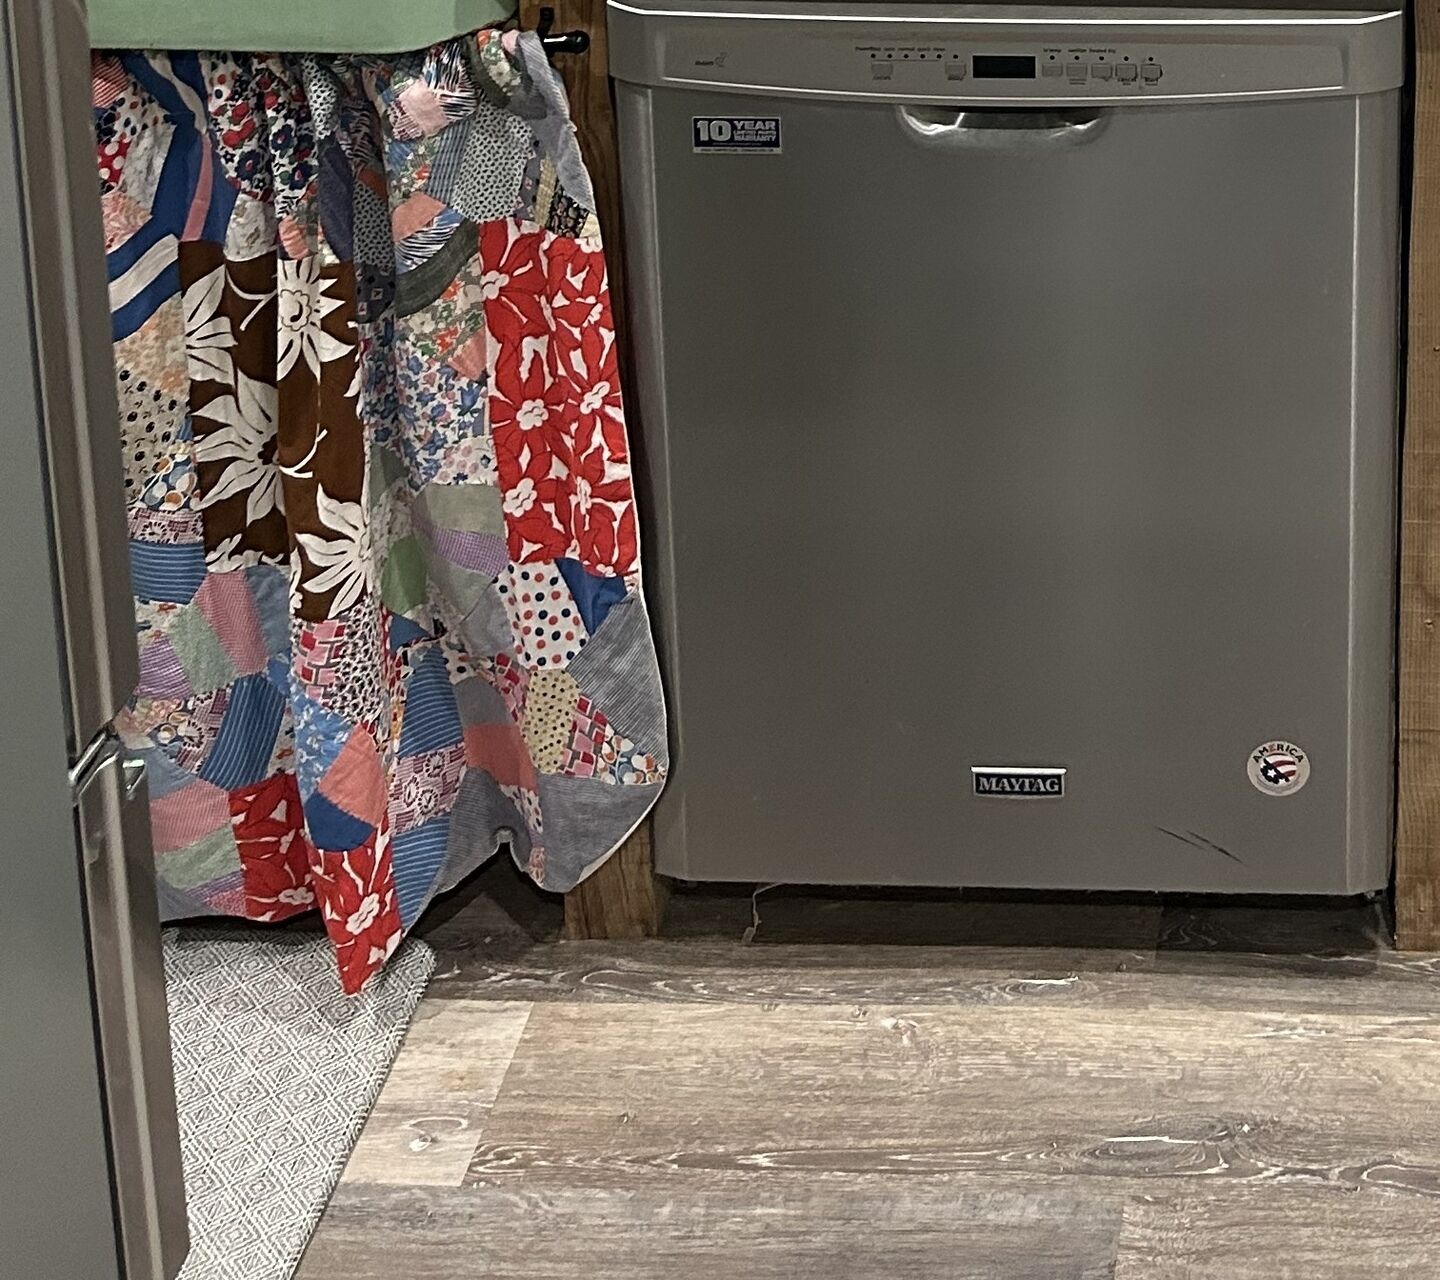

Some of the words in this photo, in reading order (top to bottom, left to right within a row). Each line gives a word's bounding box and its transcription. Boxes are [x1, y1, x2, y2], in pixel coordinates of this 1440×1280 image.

[697, 120, 732, 142] 10
[733, 121, 776, 130] YEAR
[1253, 743, 1304, 764] AMERICA
[978, 776, 1060, 792] MAYTAG
